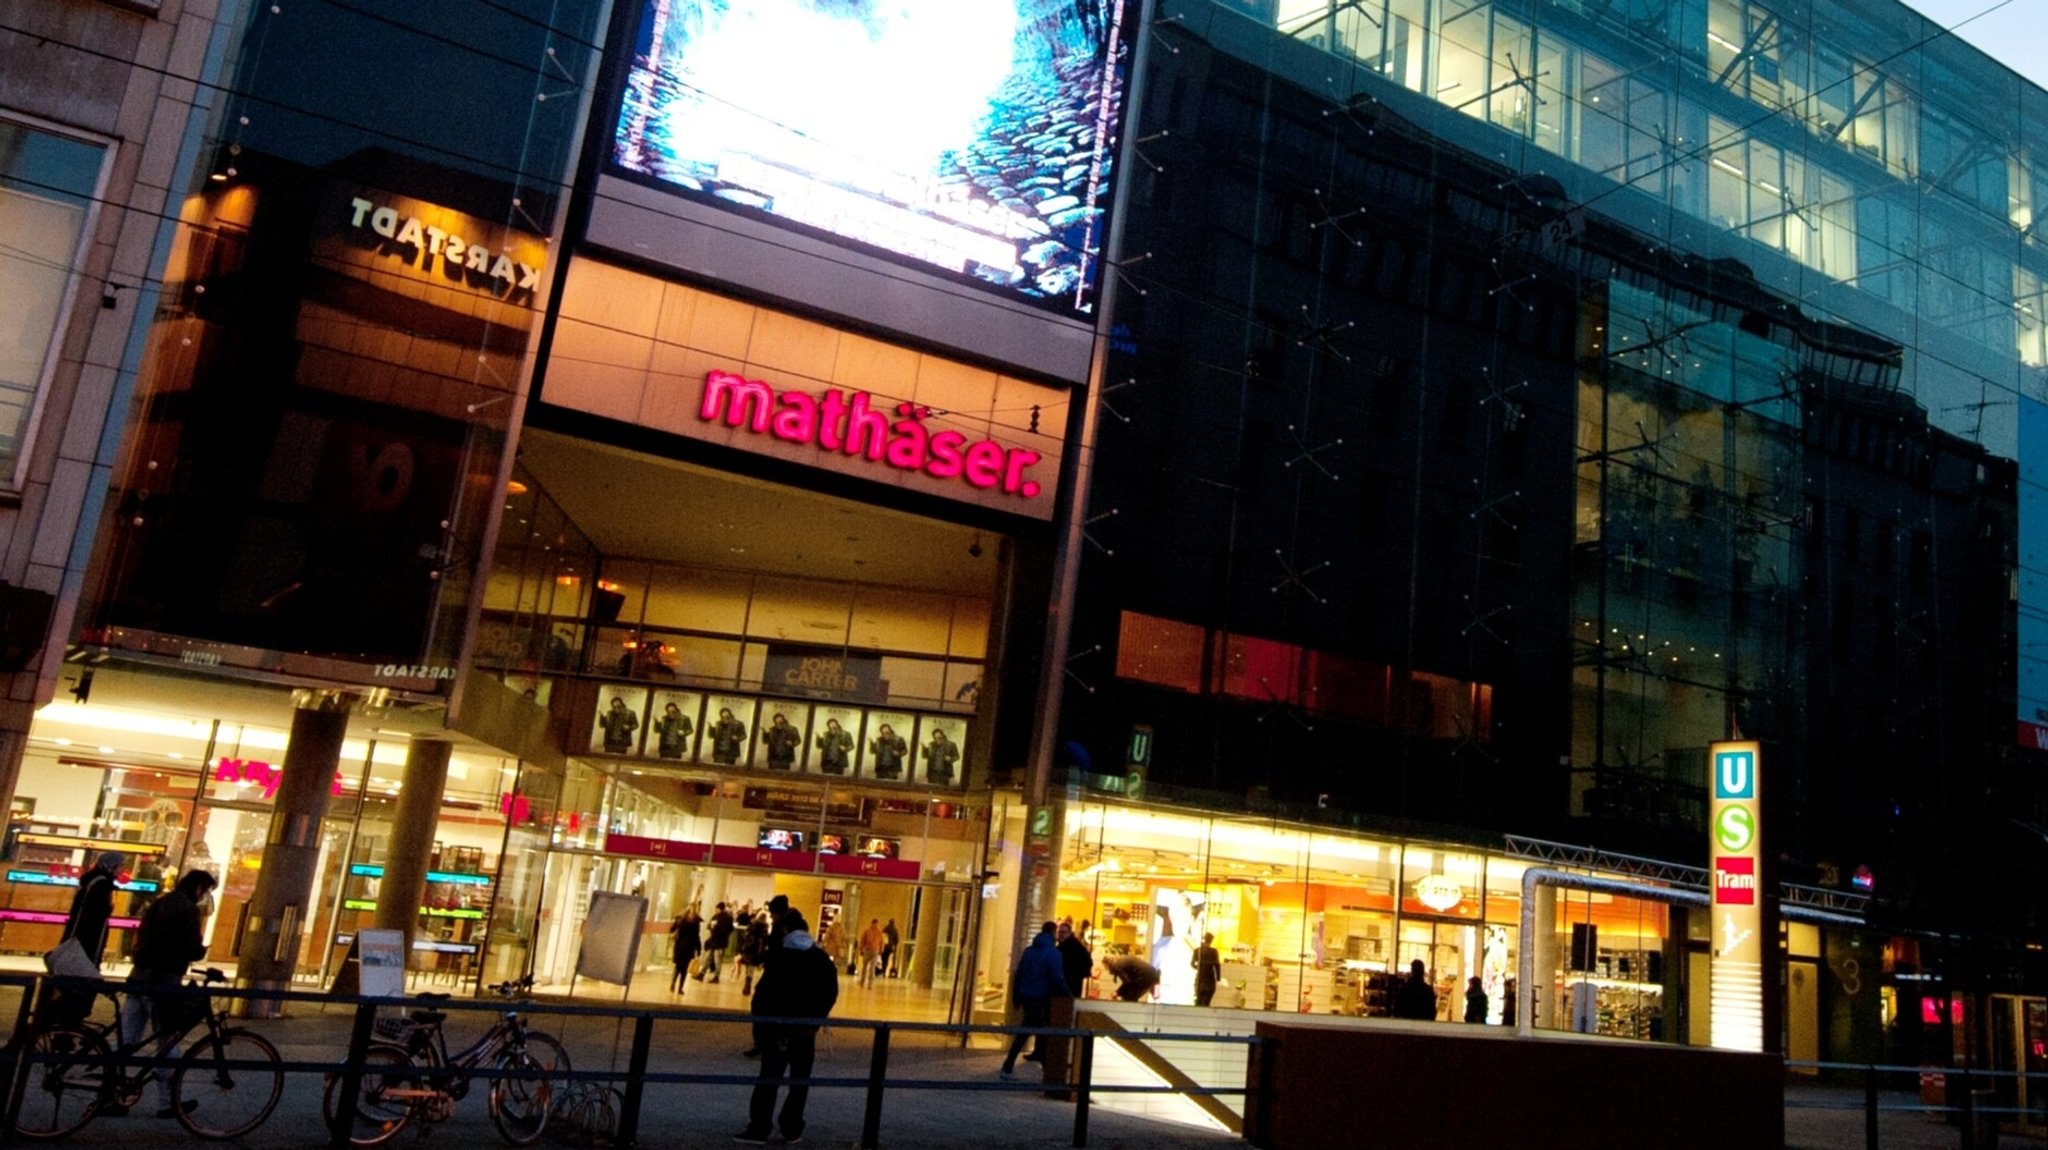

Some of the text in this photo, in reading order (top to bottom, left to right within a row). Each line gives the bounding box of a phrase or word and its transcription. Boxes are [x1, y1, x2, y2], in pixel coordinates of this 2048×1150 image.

[699, 369, 1042, 498] mathäser.
[785, 669, 858, 691] CARTER
[1722, 756, 1747, 794] U
[1721, 807, 1750, 850] S
[1716, 869, 1754, 889] Tram
